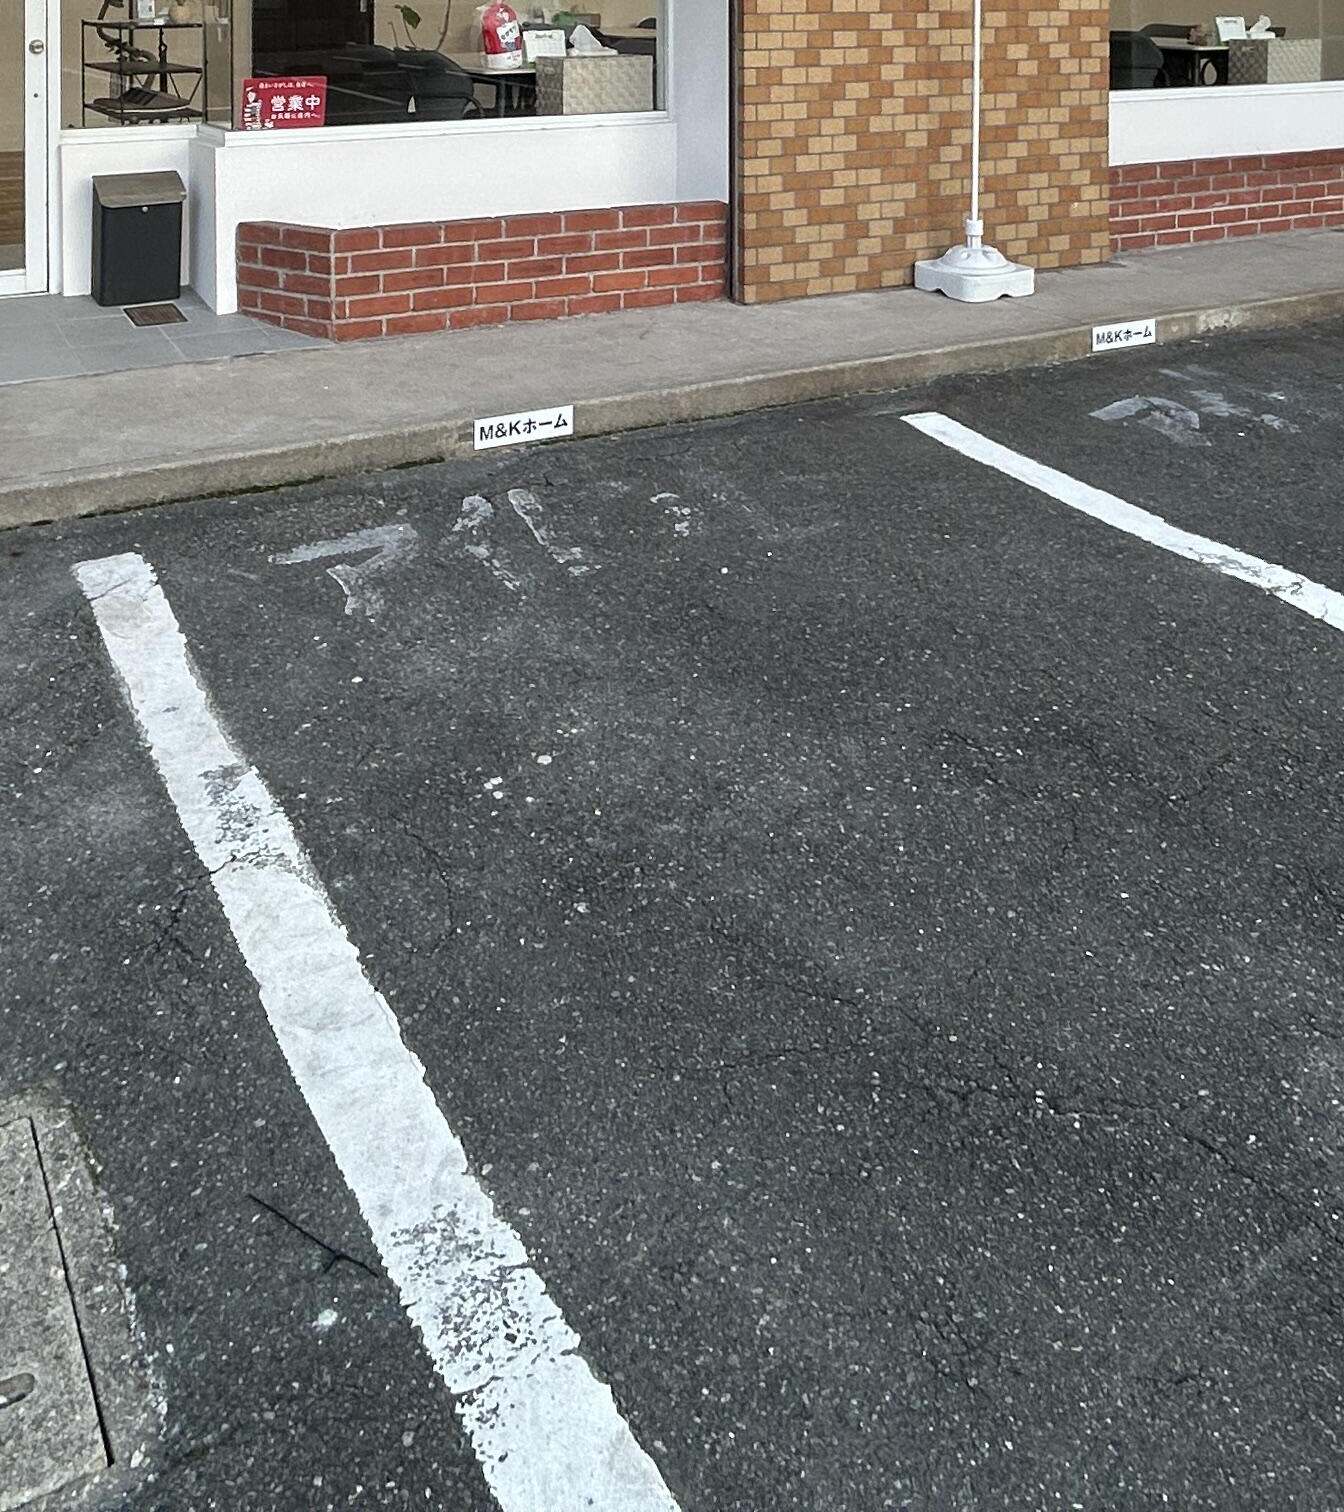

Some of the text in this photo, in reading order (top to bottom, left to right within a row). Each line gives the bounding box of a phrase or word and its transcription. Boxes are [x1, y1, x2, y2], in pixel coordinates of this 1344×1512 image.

[271, 94, 320, 112] 営業中
[1096, 325, 1153, 345] M&Kホーム
[479, 413, 568, 441] M&Kホーム
